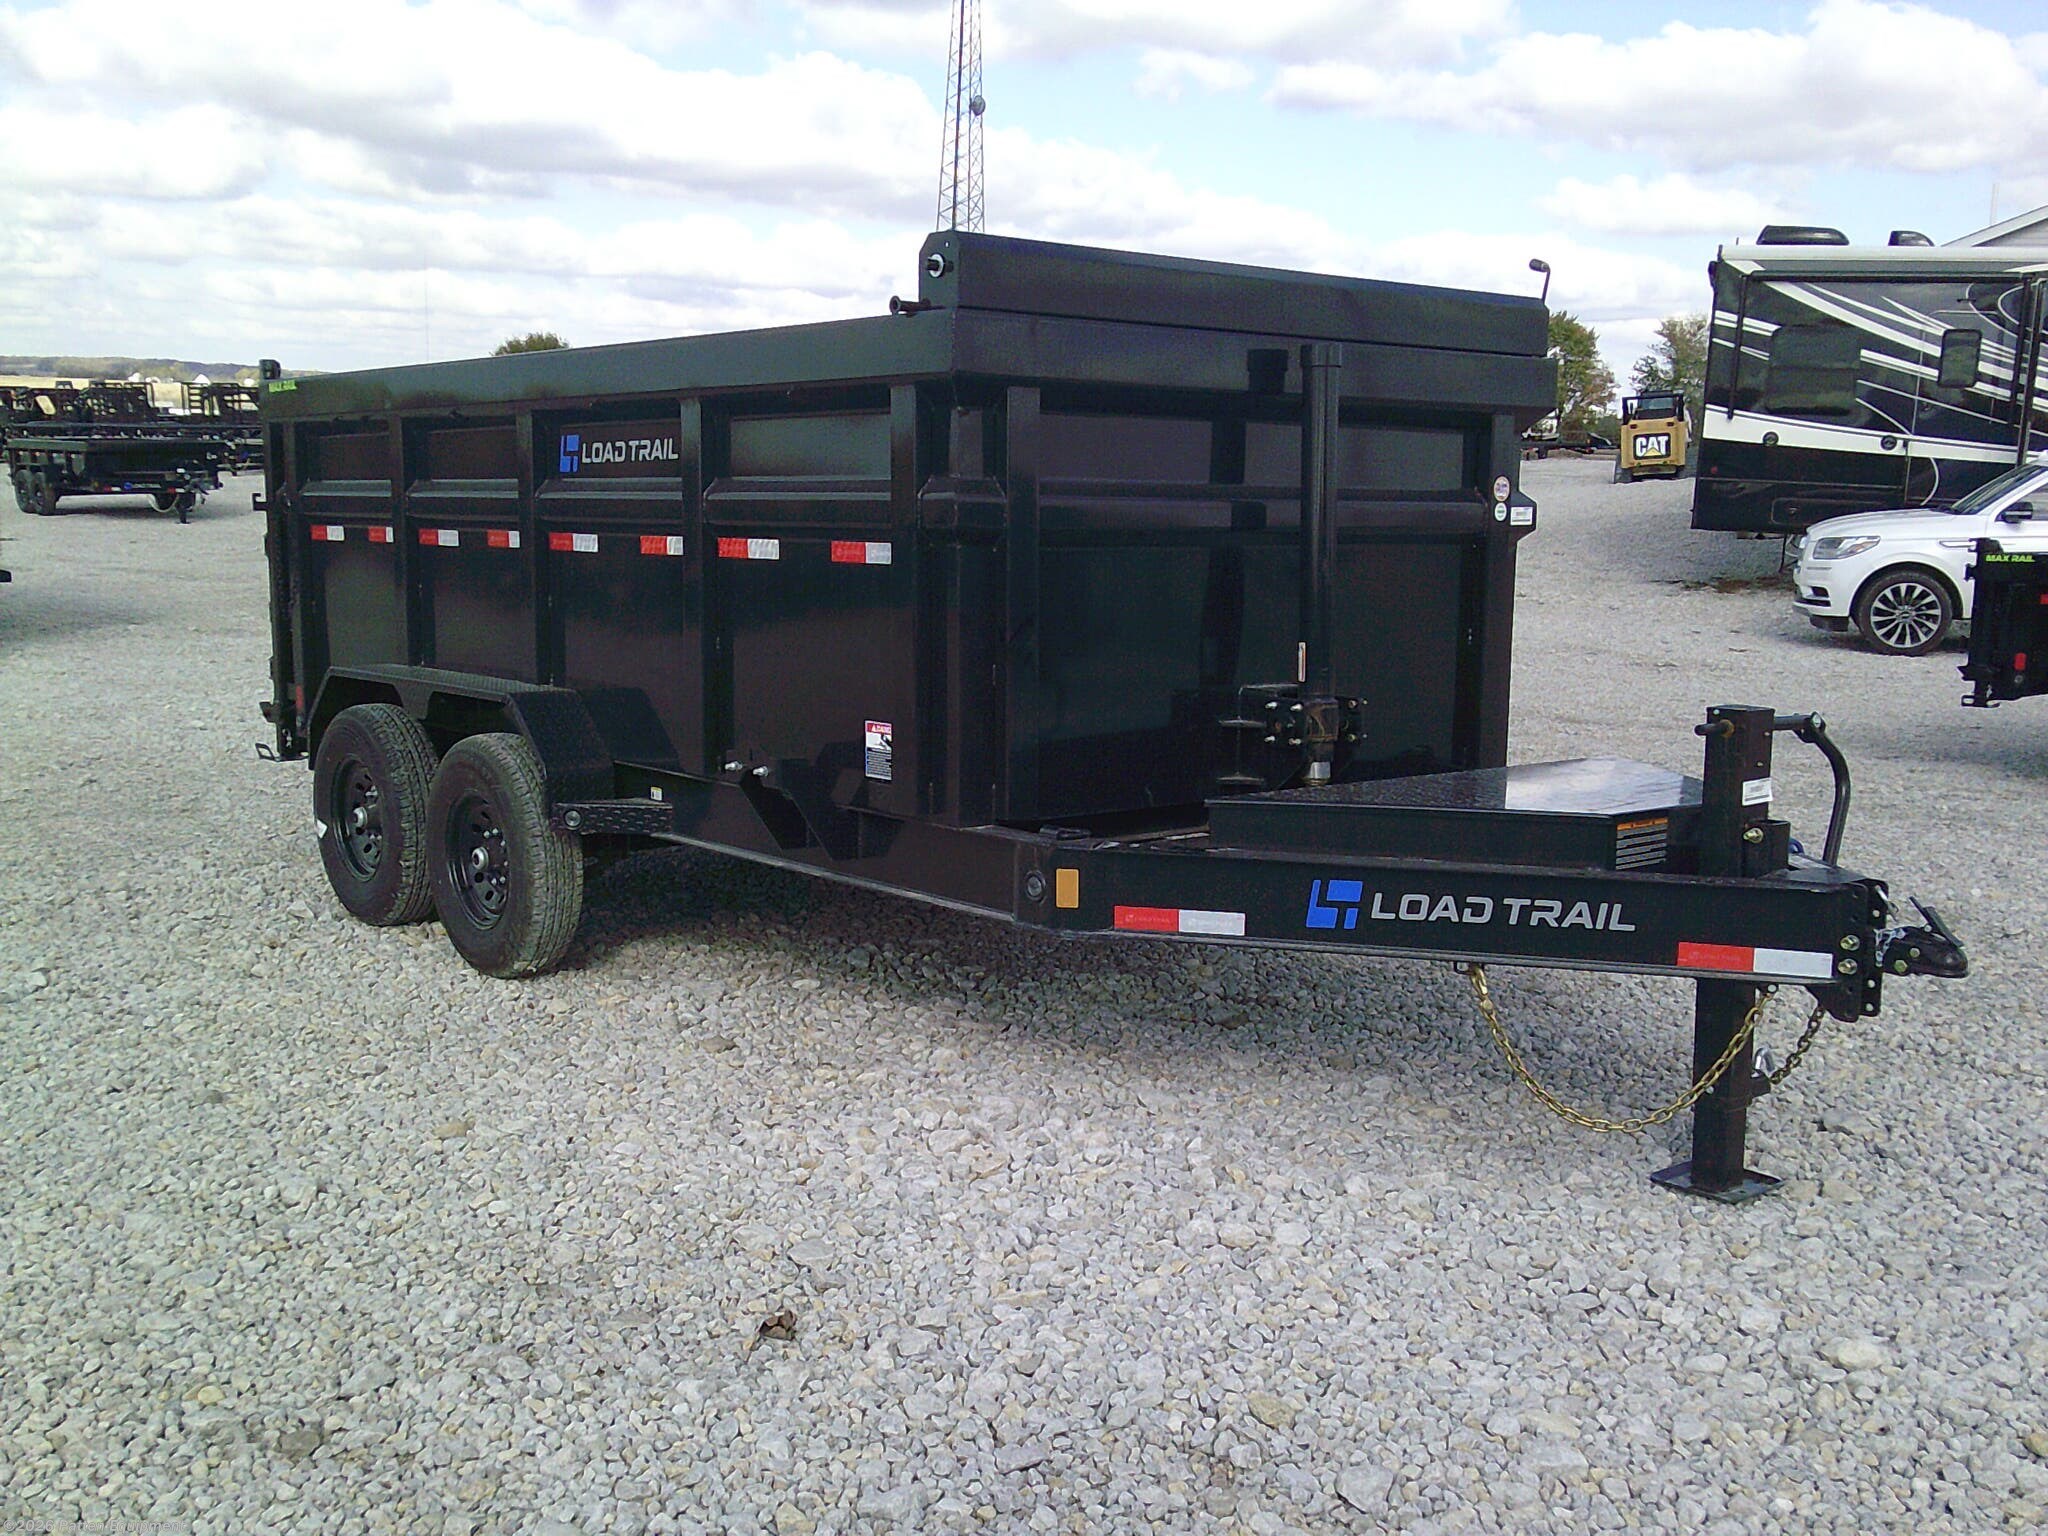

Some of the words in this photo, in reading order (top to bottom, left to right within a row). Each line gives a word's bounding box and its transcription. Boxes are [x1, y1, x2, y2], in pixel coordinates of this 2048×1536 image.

[581, 441, 626, 463] LOAD
[628, 437, 679, 462] TRAIL
[1635, 435, 1669, 457] CAT
[1985, 554, 2009, 562] MAX
[1371, 892, 1494, 924] LOAD
[1503, 897, 1636, 932] TRAIL
